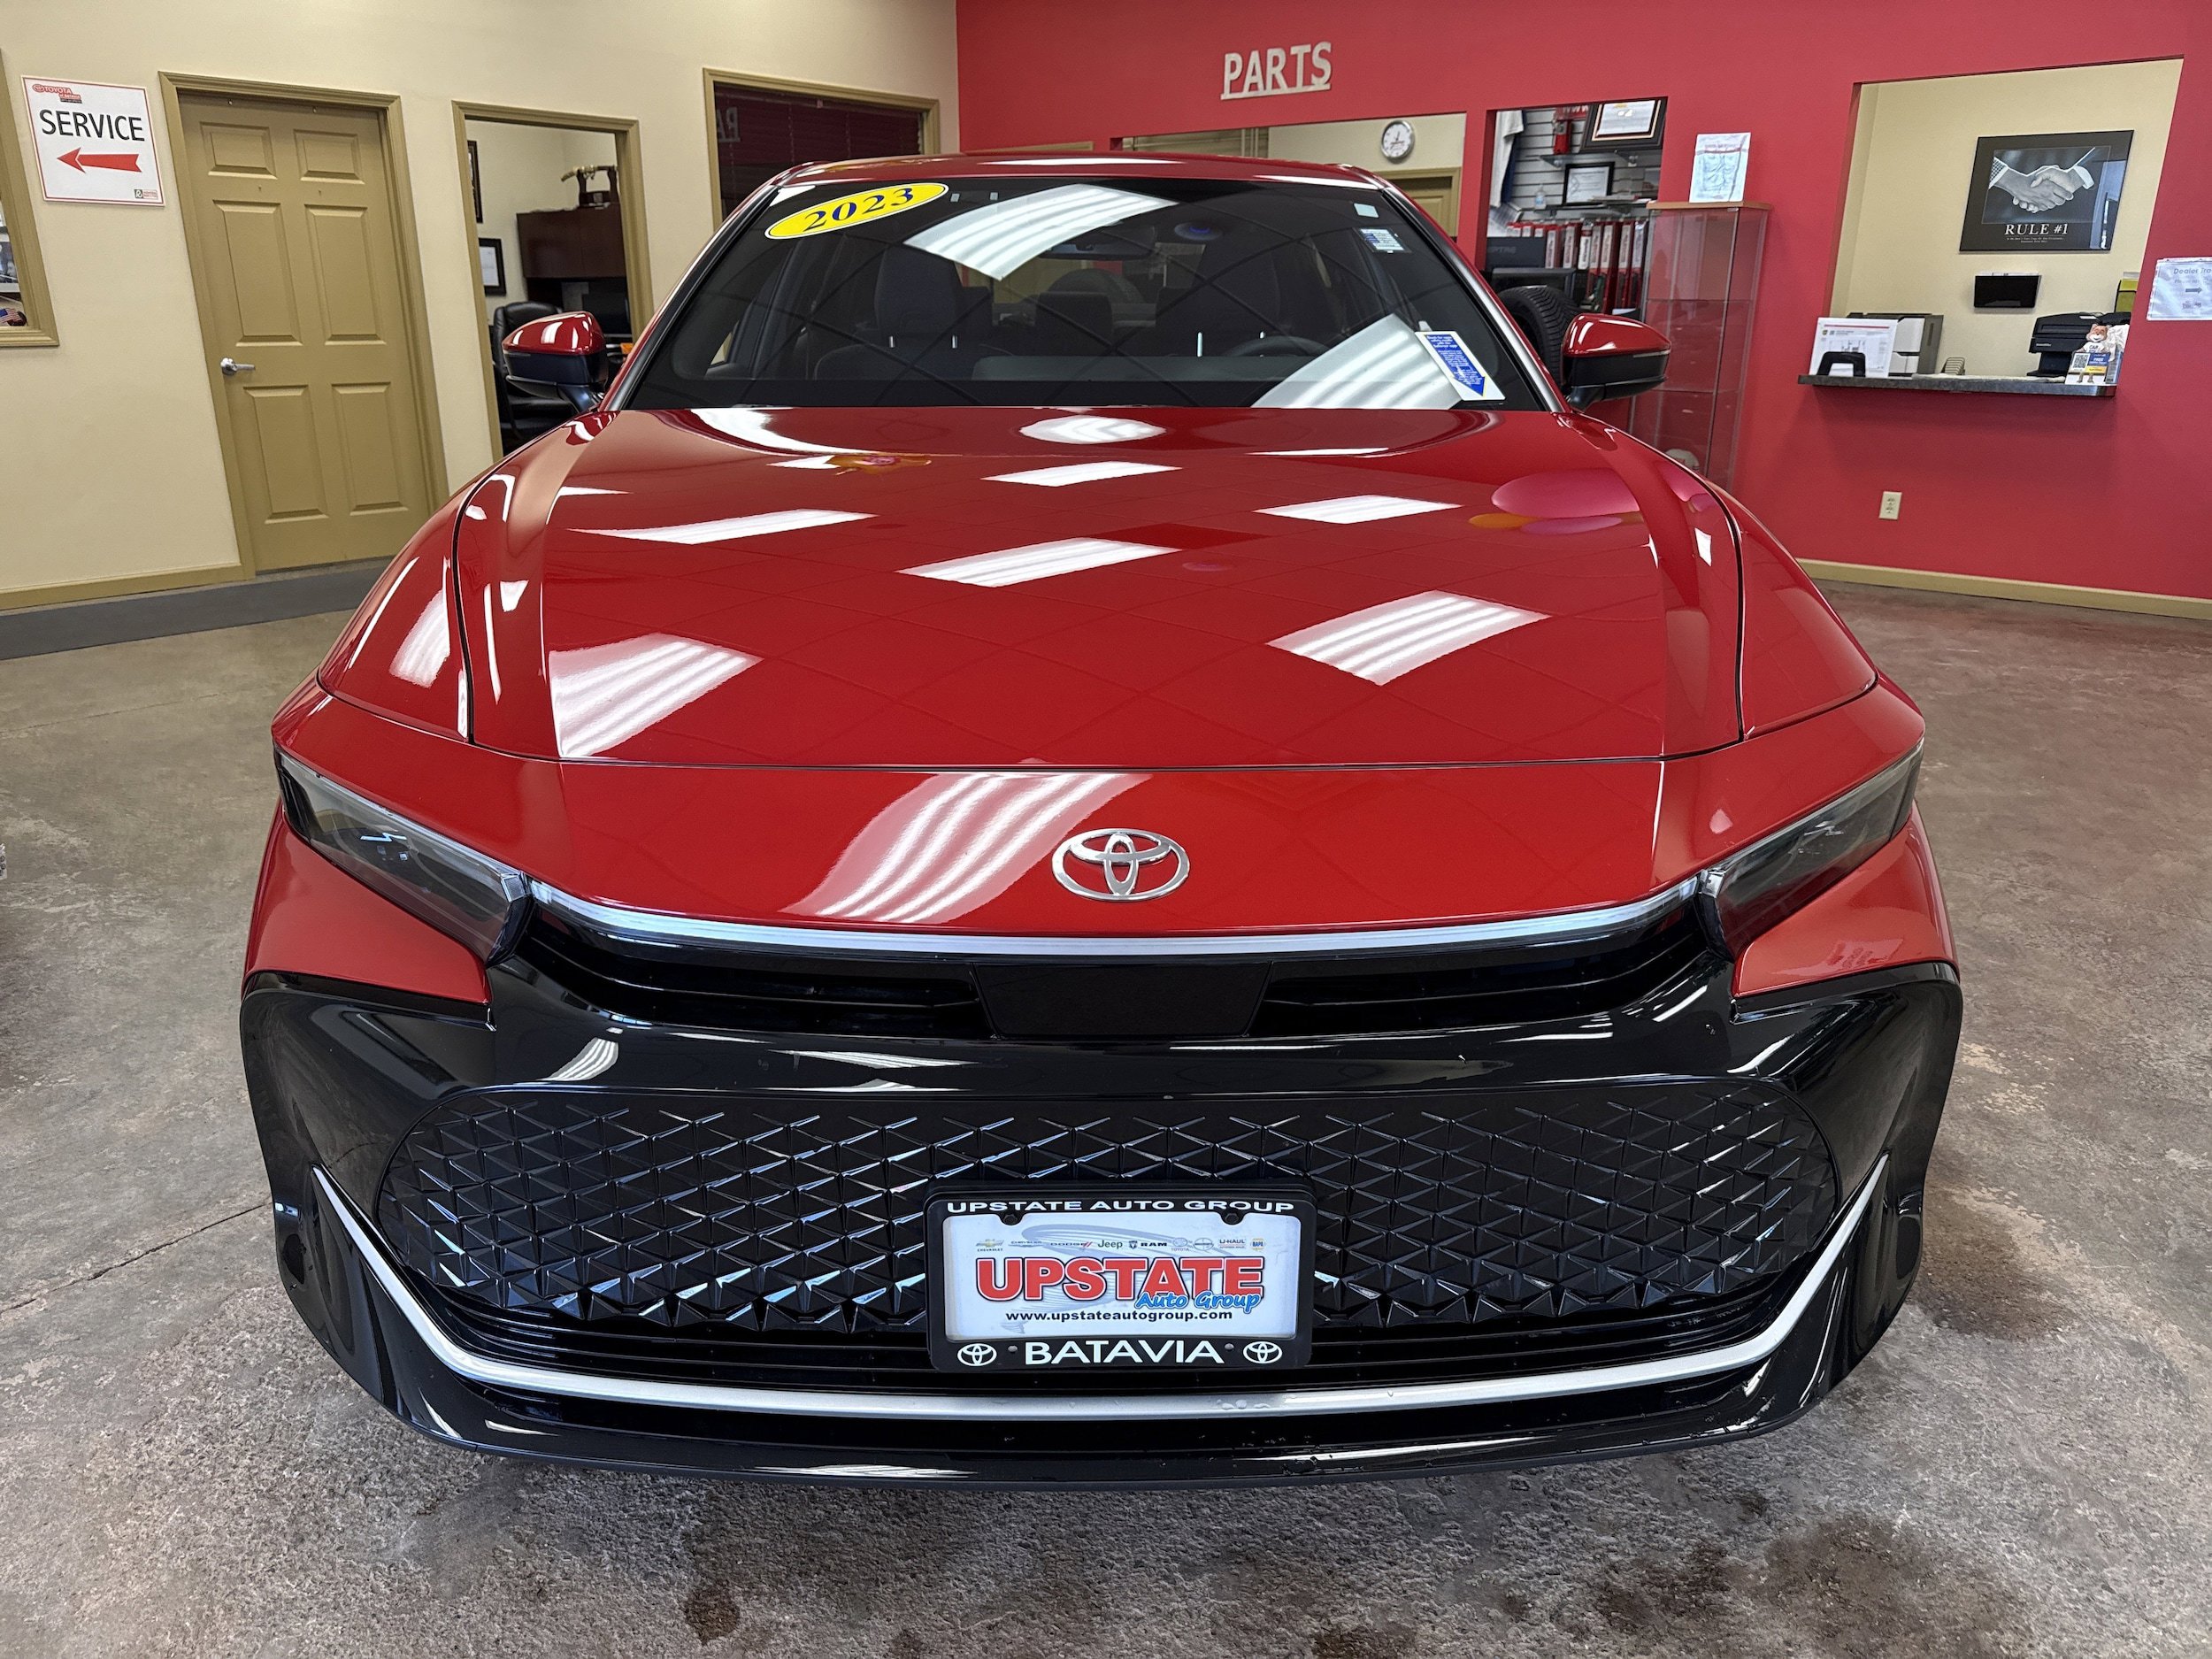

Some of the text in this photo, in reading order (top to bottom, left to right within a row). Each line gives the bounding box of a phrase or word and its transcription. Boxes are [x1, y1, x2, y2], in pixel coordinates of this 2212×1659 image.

[1222, 41, 1332, 98] PARTS
[39, 109, 145, 141] SERVICE
[803, 188, 870, 232] 2023
[2004, 223, 2068, 235] RULE #1
[947, 1200, 1294, 1213] UPSTATE AUTO GROUP
[1097, 1240, 1123, 1249] Jeep
[976, 1256, 1264, 1301] UPSTATE
[1136, 1291, 1262, 1313] Auto Group
[1005, 1310, 1233, 1322] www.upstateautogroup.com
[1025, 1340, 1225, 1365] BATAVIA
